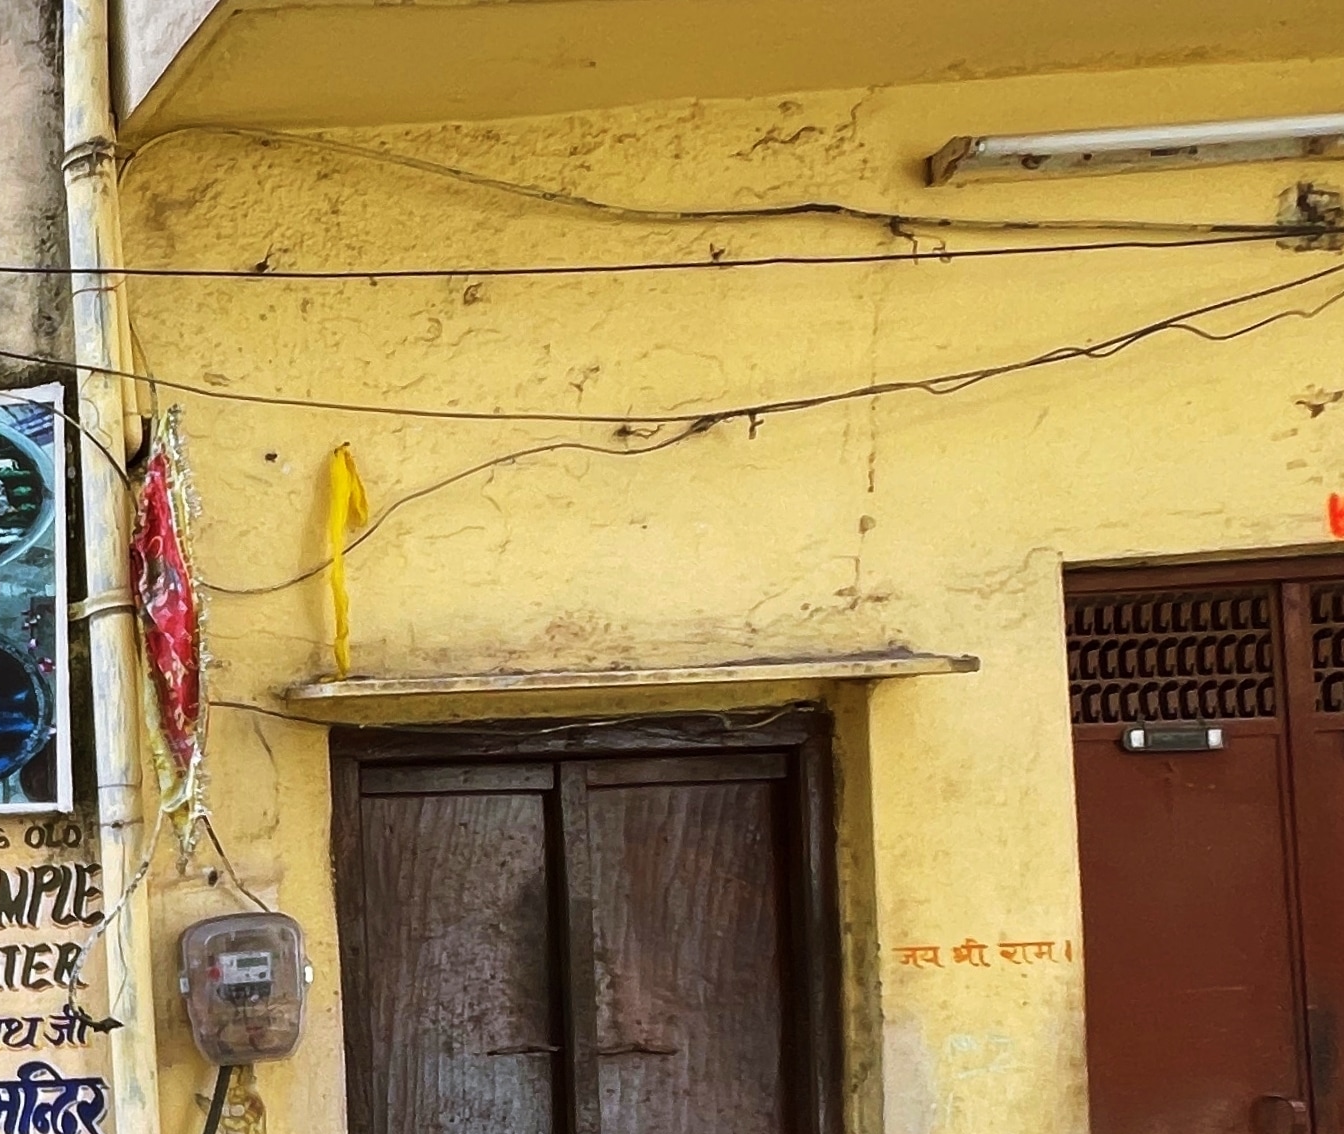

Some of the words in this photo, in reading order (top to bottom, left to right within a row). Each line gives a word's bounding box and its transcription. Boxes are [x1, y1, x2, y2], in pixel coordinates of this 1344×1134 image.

[24, 822, 82, 849] OLD
[892, 946, 944, 968] जय
[43, 1004, 90, 1046] जी
